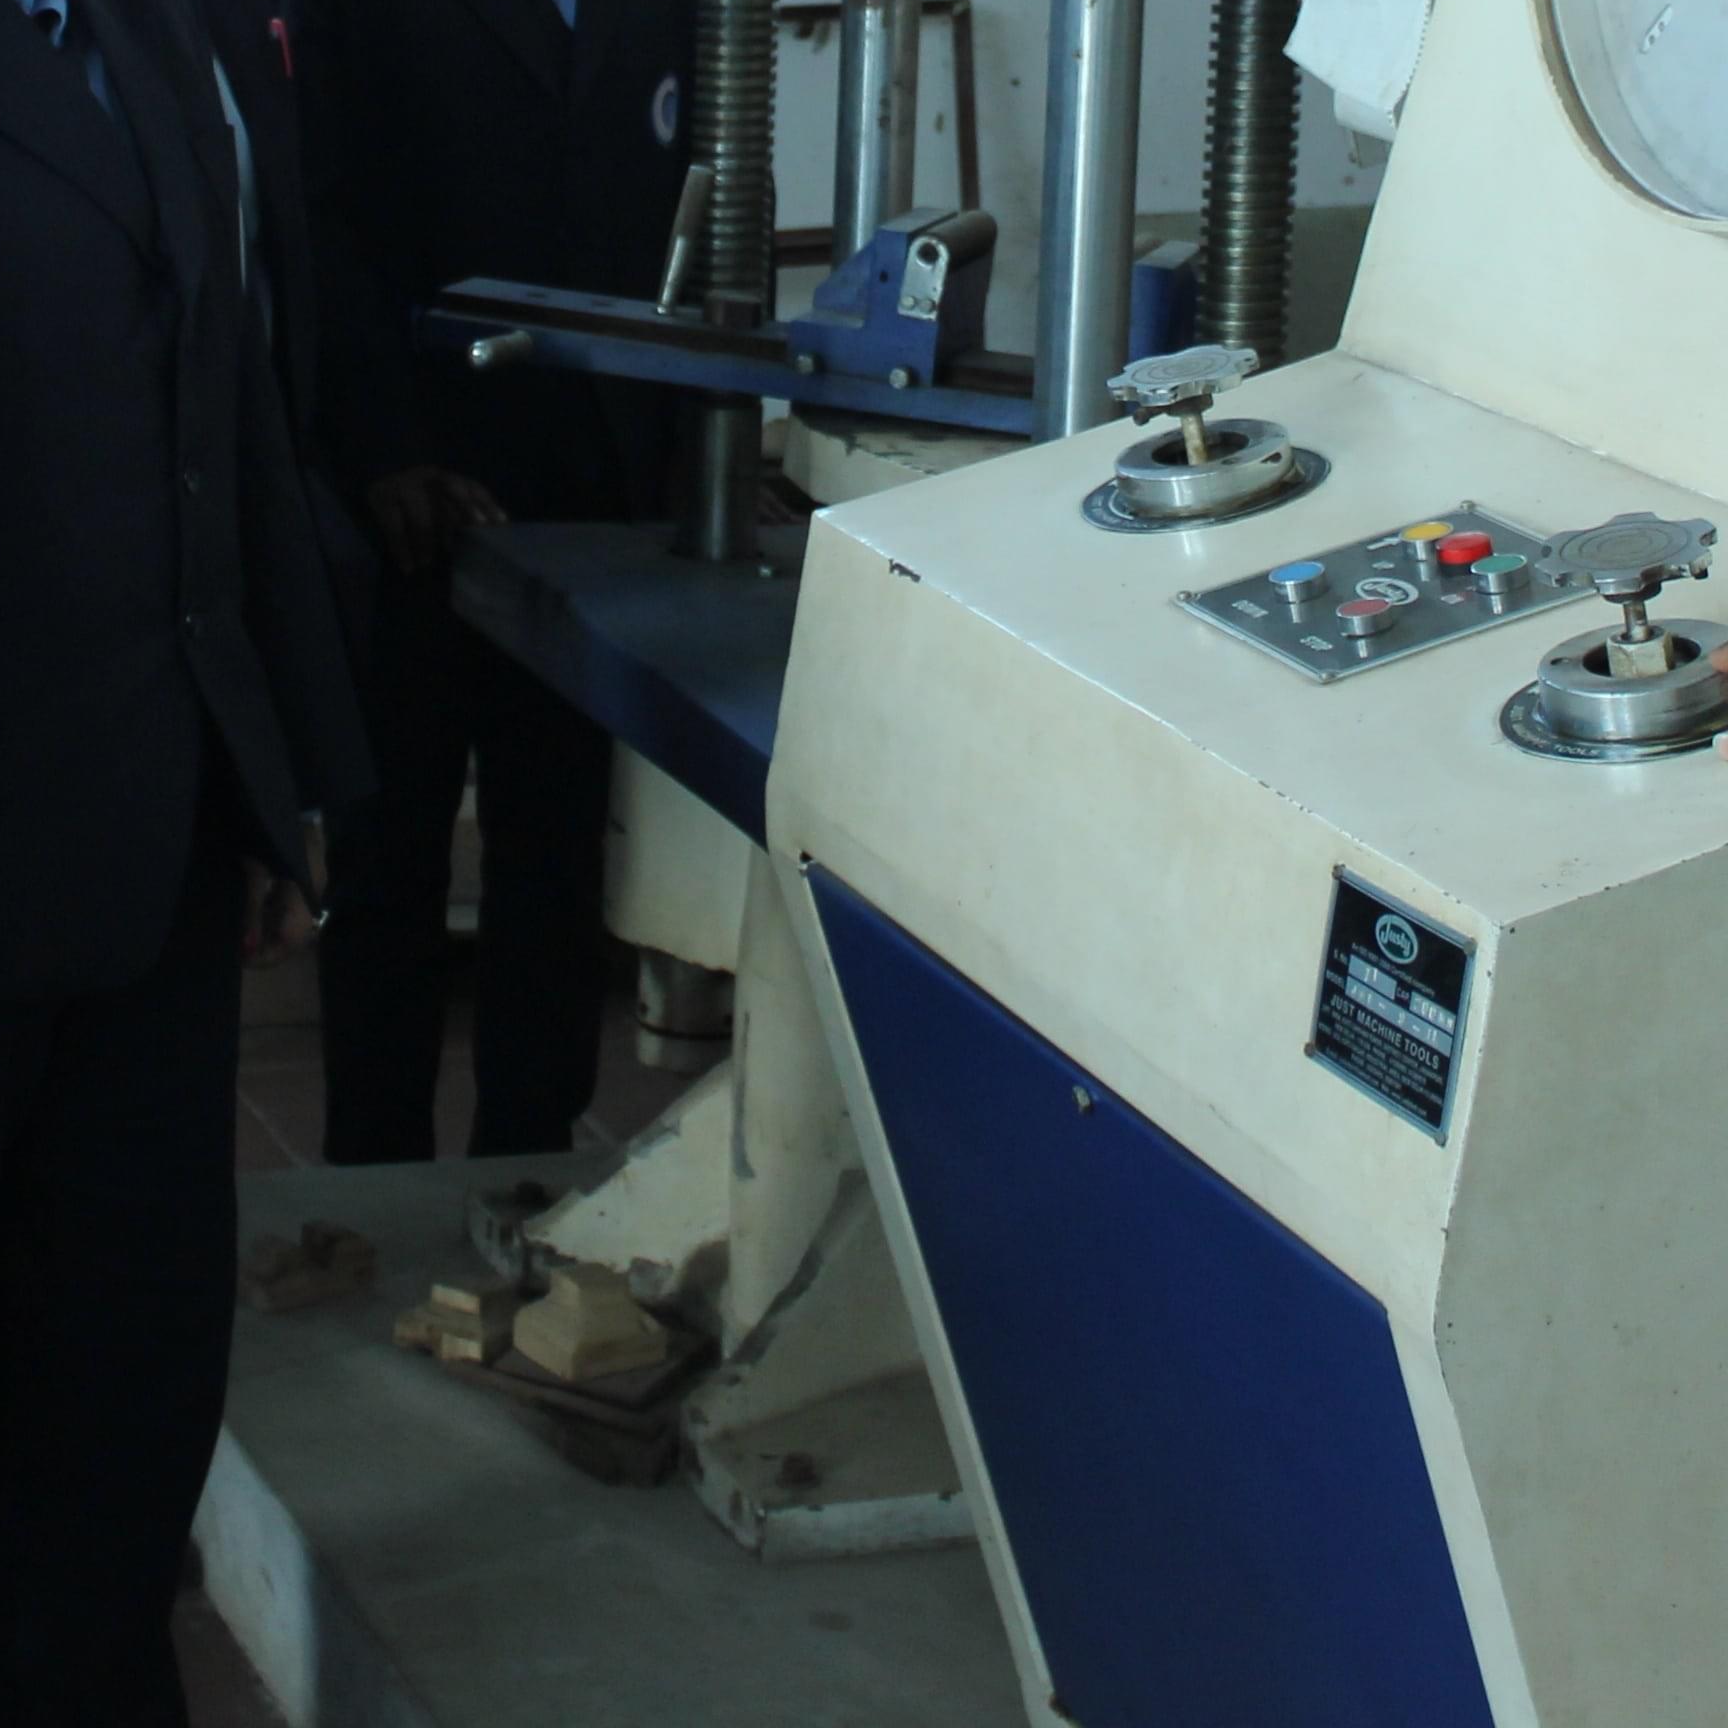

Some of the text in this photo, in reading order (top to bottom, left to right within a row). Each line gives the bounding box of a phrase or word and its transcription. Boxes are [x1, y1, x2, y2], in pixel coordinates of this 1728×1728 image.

[1331, 994, 1355, 1020] JUST
[1356, 1009, 1403, 1048] MACHINE
[1404, 1037, 1441, 1070] TOOLS
